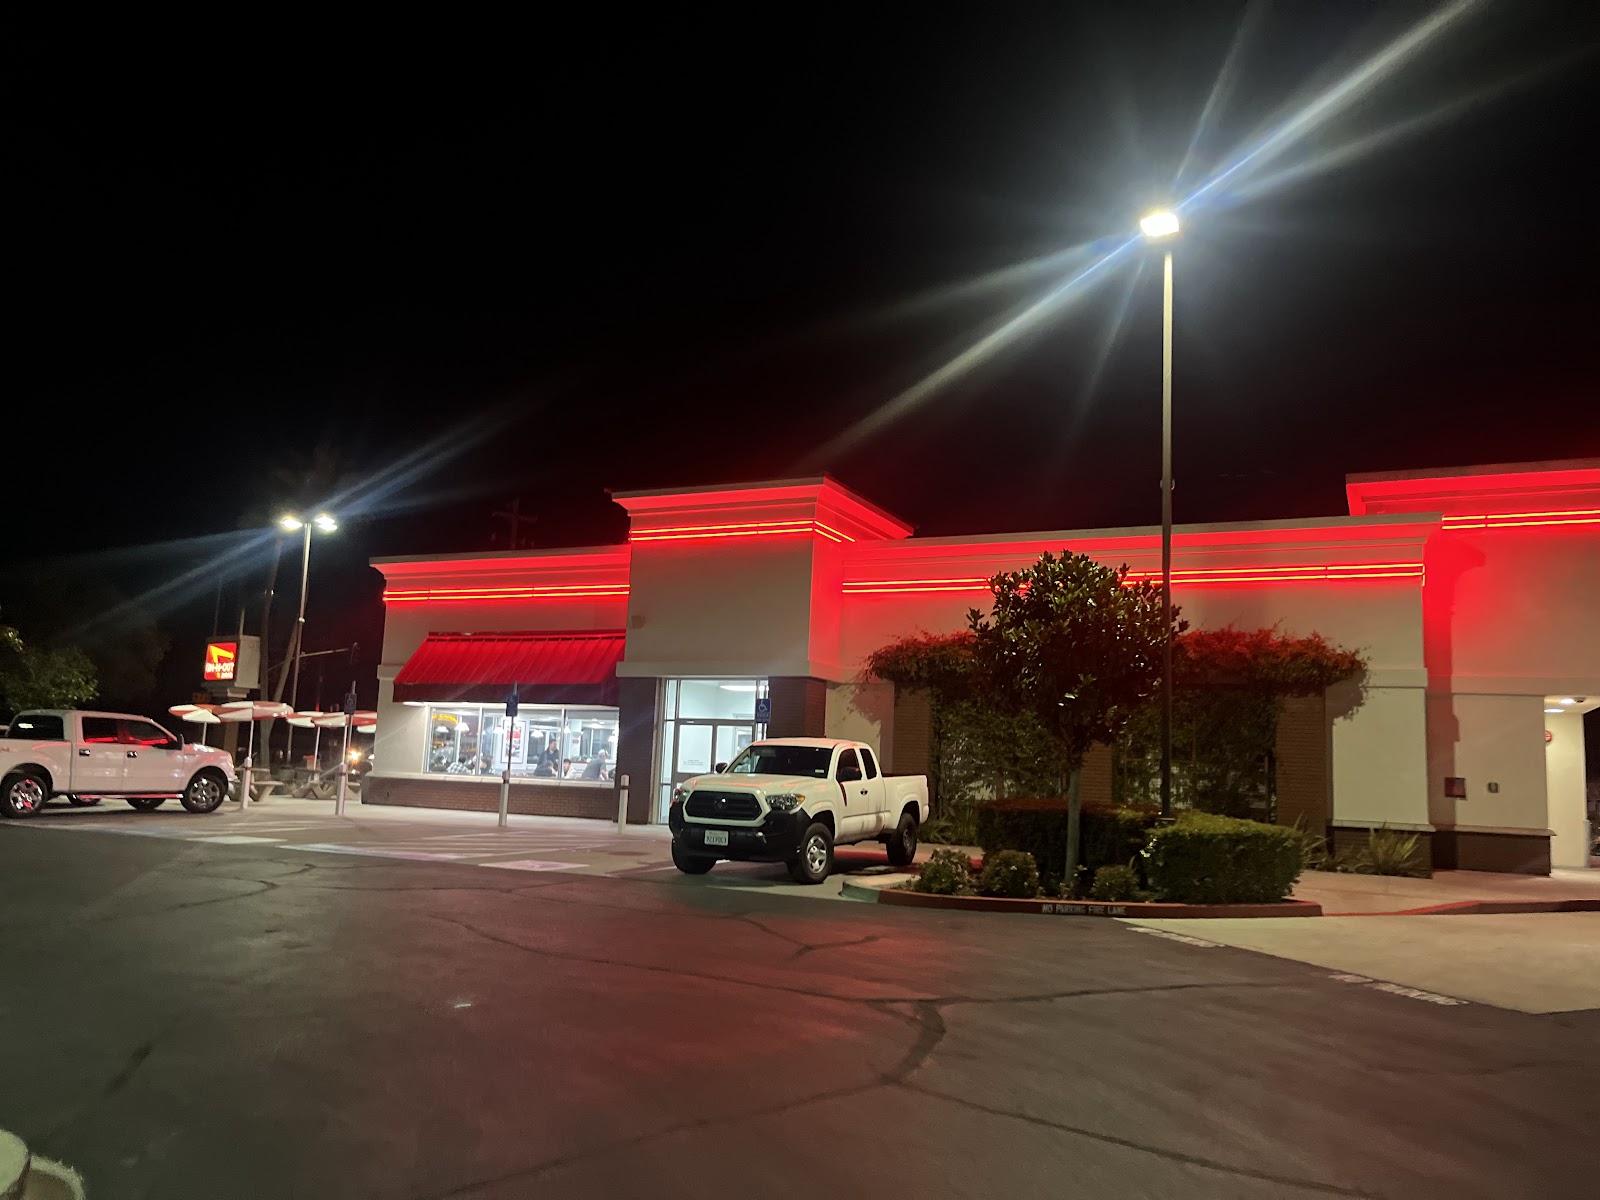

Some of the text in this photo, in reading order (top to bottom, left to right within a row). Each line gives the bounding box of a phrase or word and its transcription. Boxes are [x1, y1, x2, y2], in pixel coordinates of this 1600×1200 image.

[205, 662, 234, 673] IN-N-OUT
[1042, 904, 1053, 913] NO
[1088, 905, 1105, 914] FIRE
[1107, 906, 1126, 915] LANE
